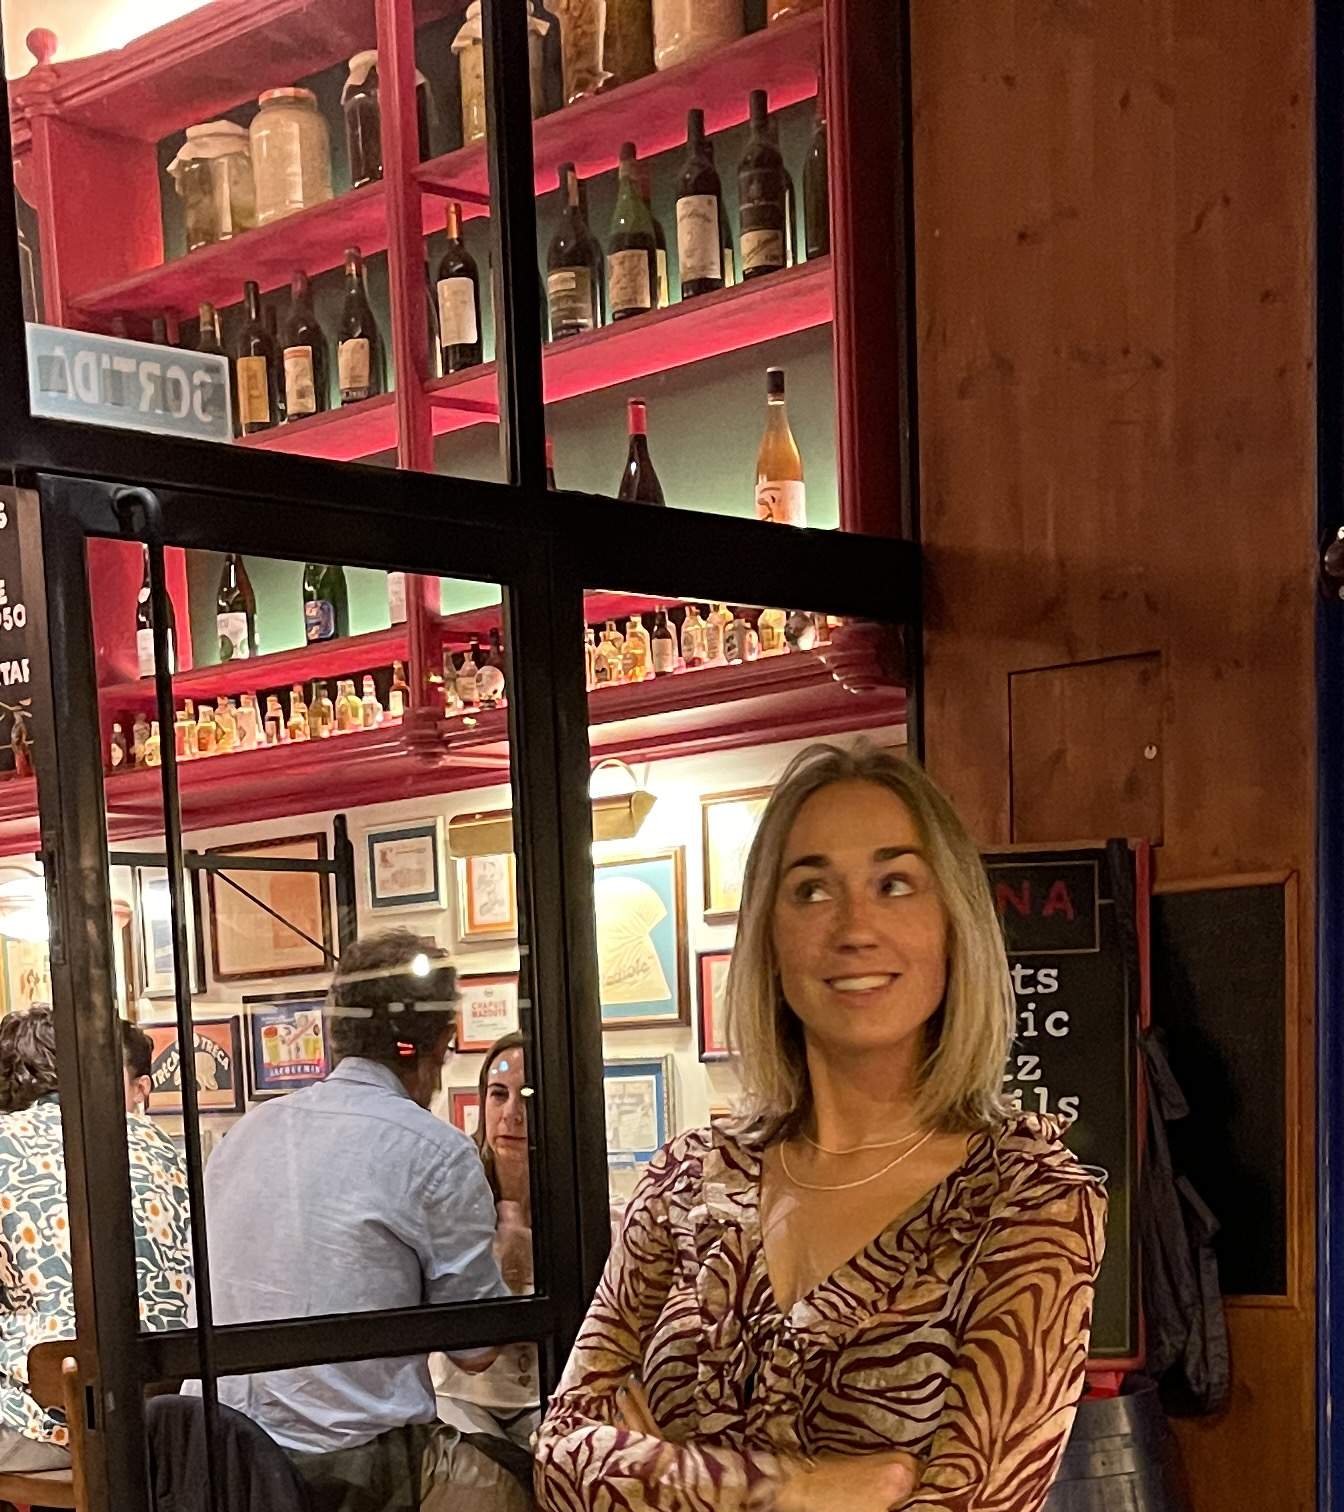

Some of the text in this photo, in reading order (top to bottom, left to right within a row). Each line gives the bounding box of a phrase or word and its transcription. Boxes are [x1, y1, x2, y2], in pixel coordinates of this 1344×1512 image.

[995, 879, 1074, 921] NA
[1011, 962, 1059, 995] ts
[1014, 1003, 1070, 1038] ic
[1003, 1055, 1043, 1081] z
[1011, 1086, 1080, 1123] ils
